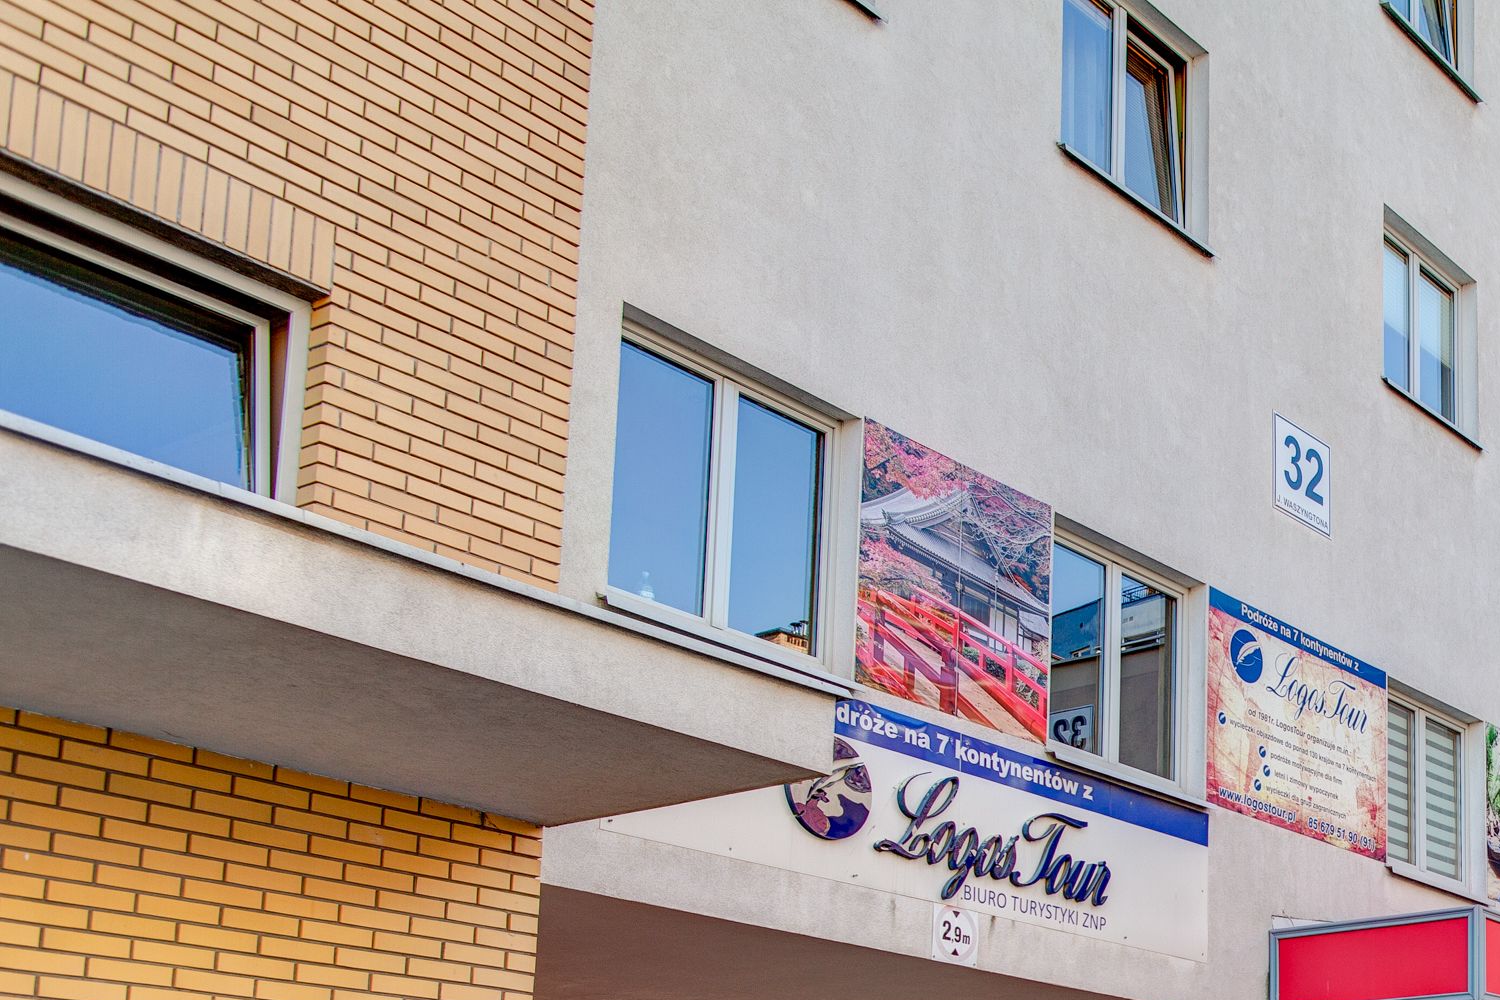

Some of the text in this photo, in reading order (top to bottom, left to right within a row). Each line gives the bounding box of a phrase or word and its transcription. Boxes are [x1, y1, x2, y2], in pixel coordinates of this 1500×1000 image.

[1284, 435, 1324, 506] 32
[1284, 497, 1329, 530] WASZYNGTONA
[1241, 604, 1360, 671] Podróże na 7 kontynentów z
[1248, 709, 1257, 717] od
[1307, 733, 1336, 751] organizuje
[904, 727, 931, 750] na
[936, 733, 949, 755] 7
[955, 739, 1079, 795] kontynentów
[1083, 784, 1094, 800] z
[1230, 719, 1256, 734] wycieczki
[1256, 729, 1284, 746] objazdowe
[1285, 741, 1292, 749] do
[1293, 744, 1309, 756] ponad
[1346, 766, 1376, 782] kontynentach
[1270, 752, 1291, 766] podróże
[1292, 761, 1324, 778] motywacyjne
[1324, 773, 1333, 782] dla
[1266, 785, 1291, 800] wycieczki
[1274, 769, 1286, 779] letni
[1289, 776, 1308, 790] zimowy
[1309, 784, 1339, 800] wypoczynek
[1218, 787, 1297, 823] www.logostour.pl
[1308, 816, 1318, 830] 85
[1320, 821, 1335, 835] 679
[1336, 827, 1346, 840] 51
[1348, 831, 1358, 844] 90
[964, 884, 1107, 931] BIURO TURYSTYKI ZNP
